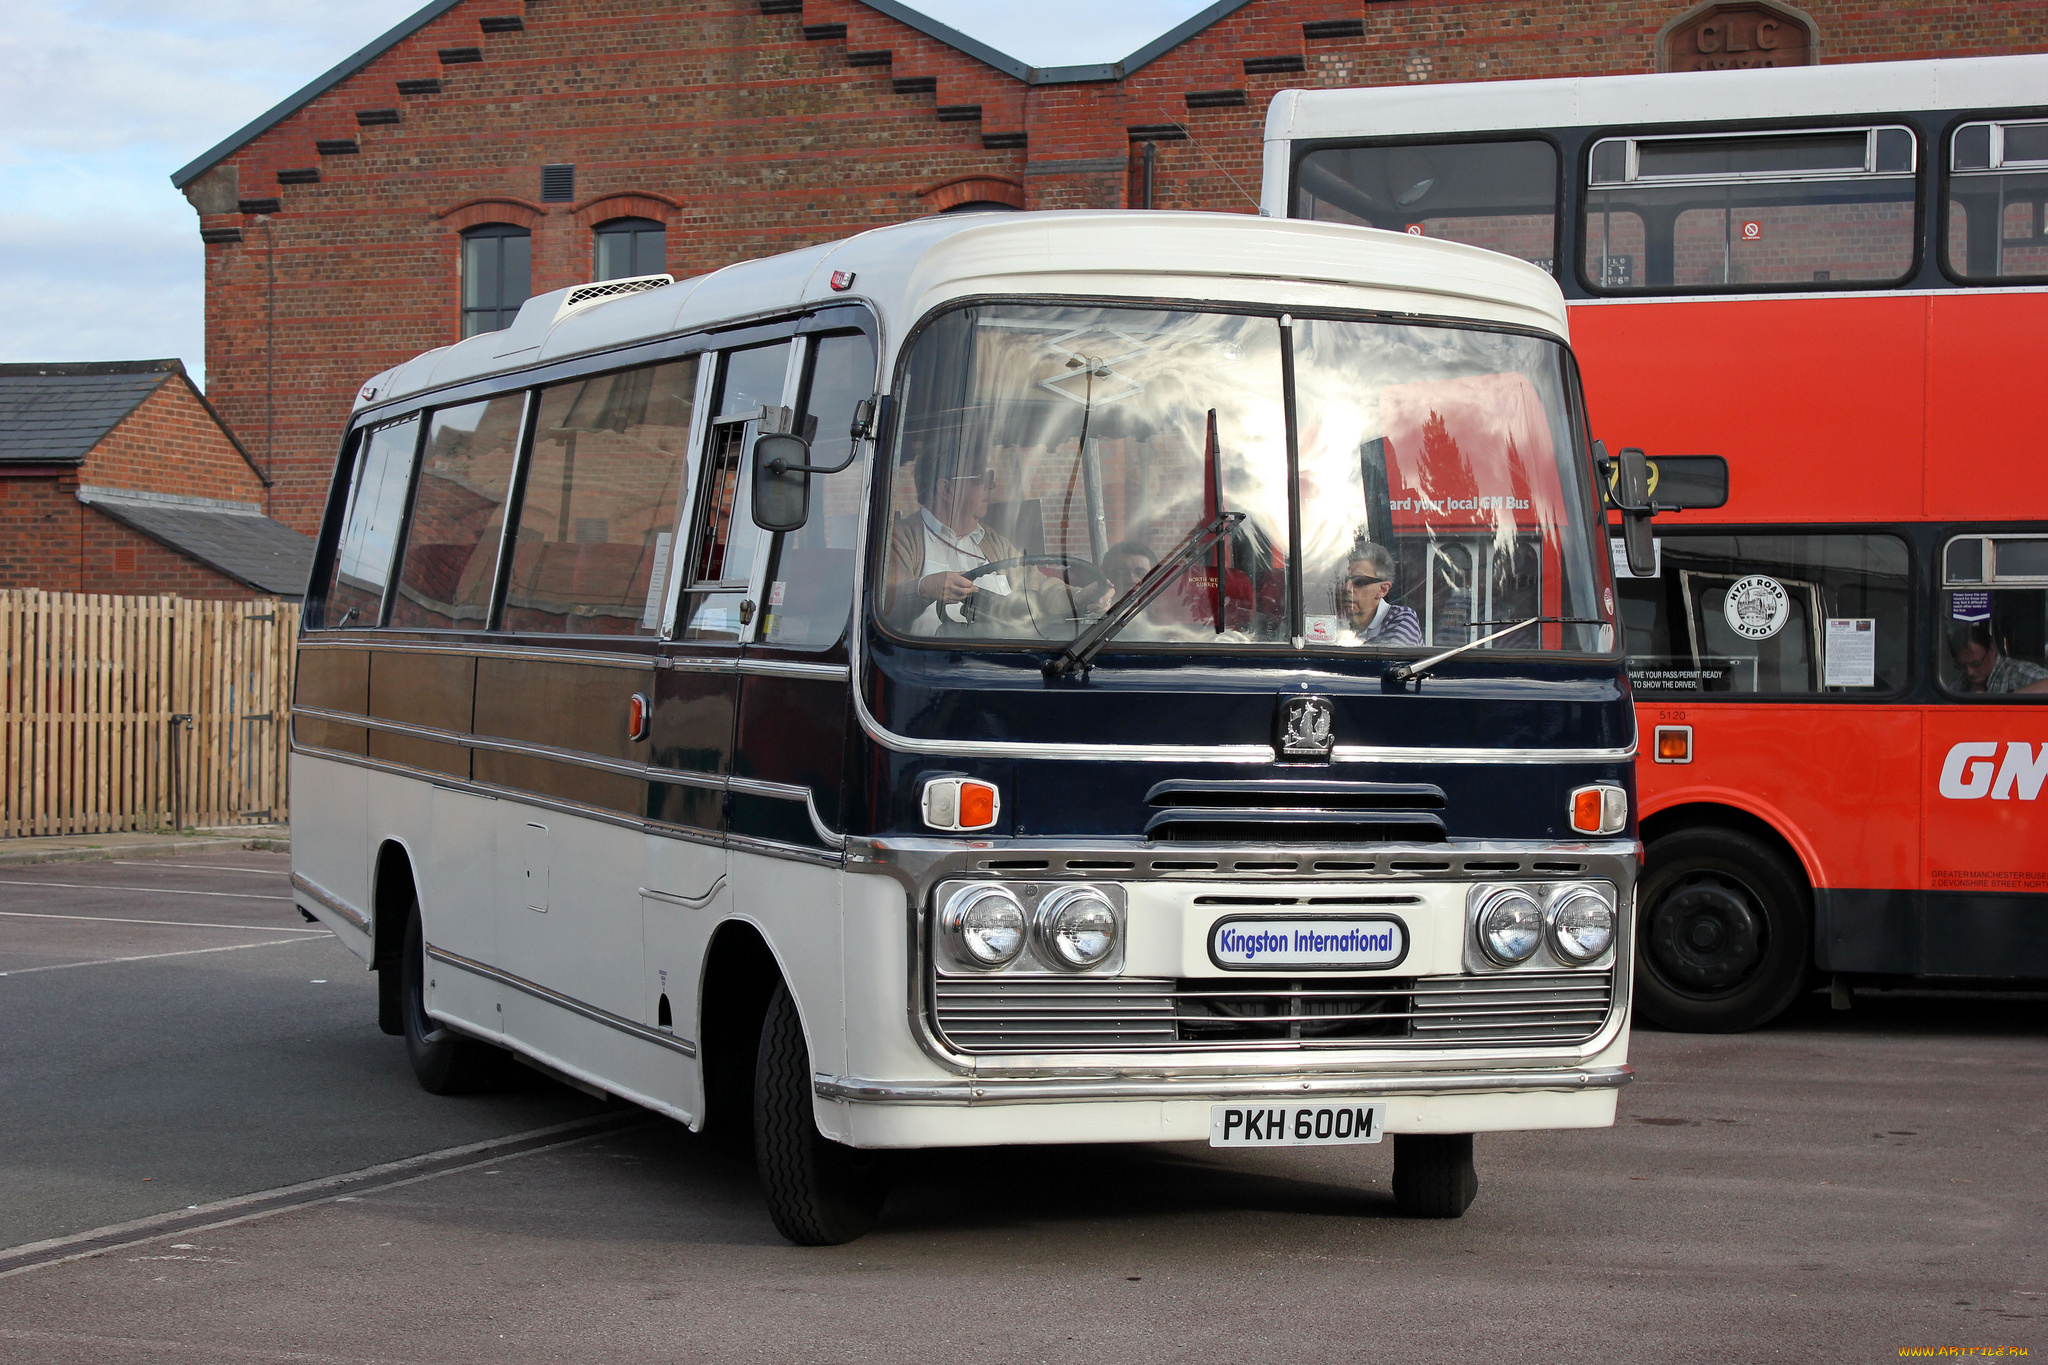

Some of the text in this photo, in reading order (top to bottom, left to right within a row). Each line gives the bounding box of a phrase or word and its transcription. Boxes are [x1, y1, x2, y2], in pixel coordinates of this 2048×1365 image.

[1697, 19, 1779, 53] CLC
[1414, 499, 1443, 513] your
[1447, 497, 1477, 511] local
[1480, 497, 1503, 510] GM
[1506, 497, 1529, 510] Bus
[1730, 579, 1783, 601] HYDE ROAD
[1738, 623, 1772, 635] DEPOT
[1628, 671, 1722, 679] HAVE YOUR PASS/PERMIT READY
[1659, 711, 1686, 720] 5120
[1931, 870, 1969, 878] GREATER
[1970, 871, 2024, 879] MANCHESTER
[1221, 928, 1393, 959] Kingston International
[1223, 1108, 1374, 1141] PKH 600M
